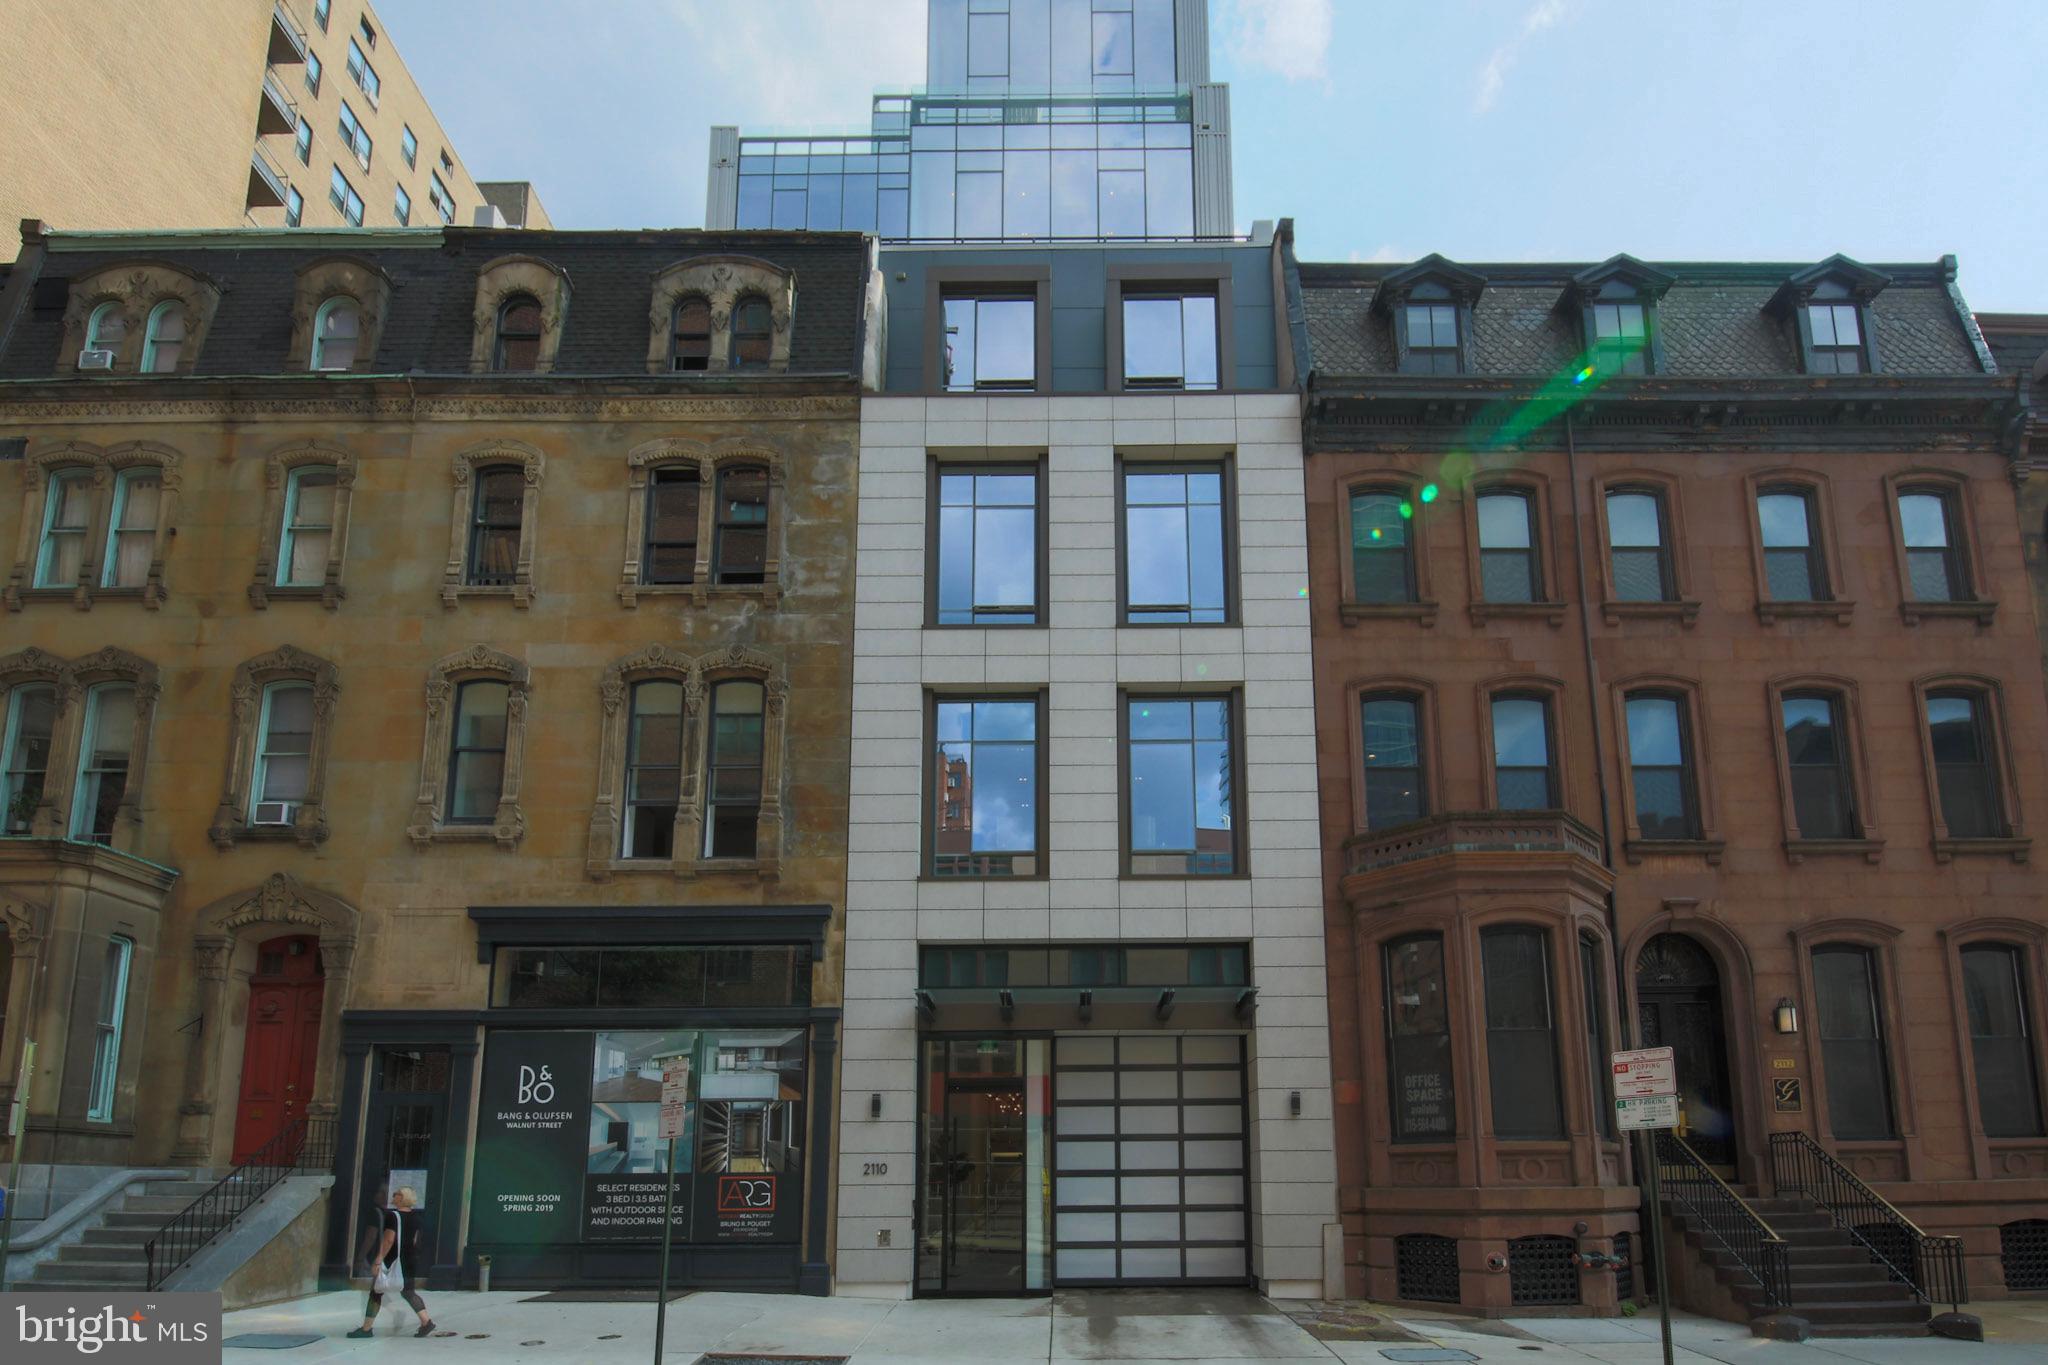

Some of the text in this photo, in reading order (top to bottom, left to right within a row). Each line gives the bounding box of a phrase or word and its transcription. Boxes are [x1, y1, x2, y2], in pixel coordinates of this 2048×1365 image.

[1629, 1062, 1661, 1072] STOPPING
[1405, 1074, 1441, 1088] OFFICE
[1406, 1088, 1443, 1102] SPACE
[1639, 1097, 1667, 1106] PARKING
[497, 1110, 573, 1120] BANG & OLUFSEN
[506, 1121, 563, 1129] WALNUT STREET
[863, 1162, 888, 1176] 2110
[597, 1183, 680, 1192] SELECT RESIDENCS
[497, 1193, 561, 1202] OPENING SOON
[722, 1180, 771, 1207] ARG
[613, 1195, 631, 1203] BED
[635, 1195, 648, 1203] 3.5
[502, 1204, 554, 1212] SPRING 2019
[591, 1206, 612, 1215] WITH
[613, 1206, 656, 1214] OUTDOOR
[590, 1217, 683, 1226] AND INDOOR PARNG
